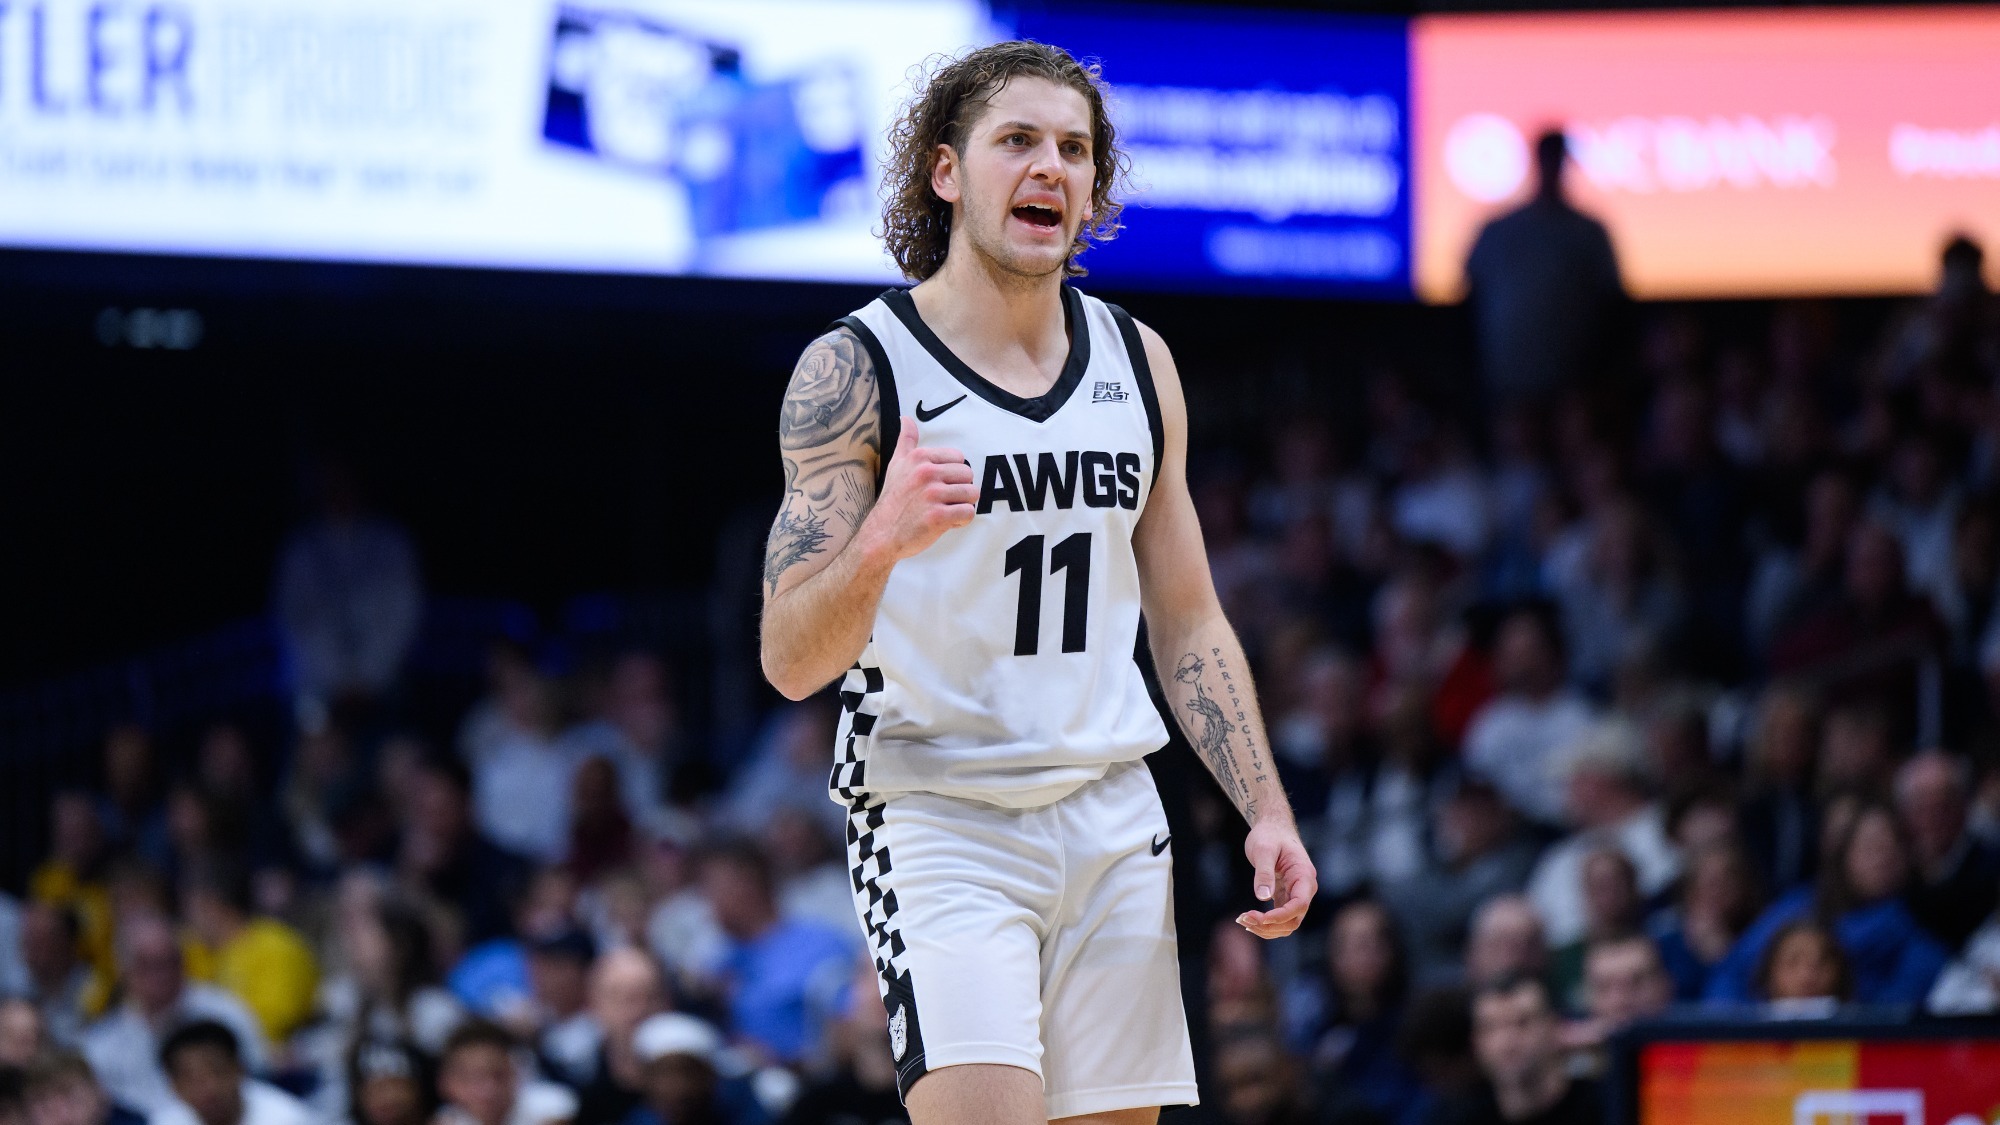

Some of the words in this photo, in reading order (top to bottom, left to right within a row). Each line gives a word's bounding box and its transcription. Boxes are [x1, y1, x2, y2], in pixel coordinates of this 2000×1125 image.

[0, 0, 199, 117] LER
[1092, 391, 1130, 401] EAST
[1094, 381, 1121, 391] BIG
[963, 450, 1141, 515] AWGS
[1004, 532, 1092, 656] 11
[1212, 647, 1267, 783] PERSPECTIVE
